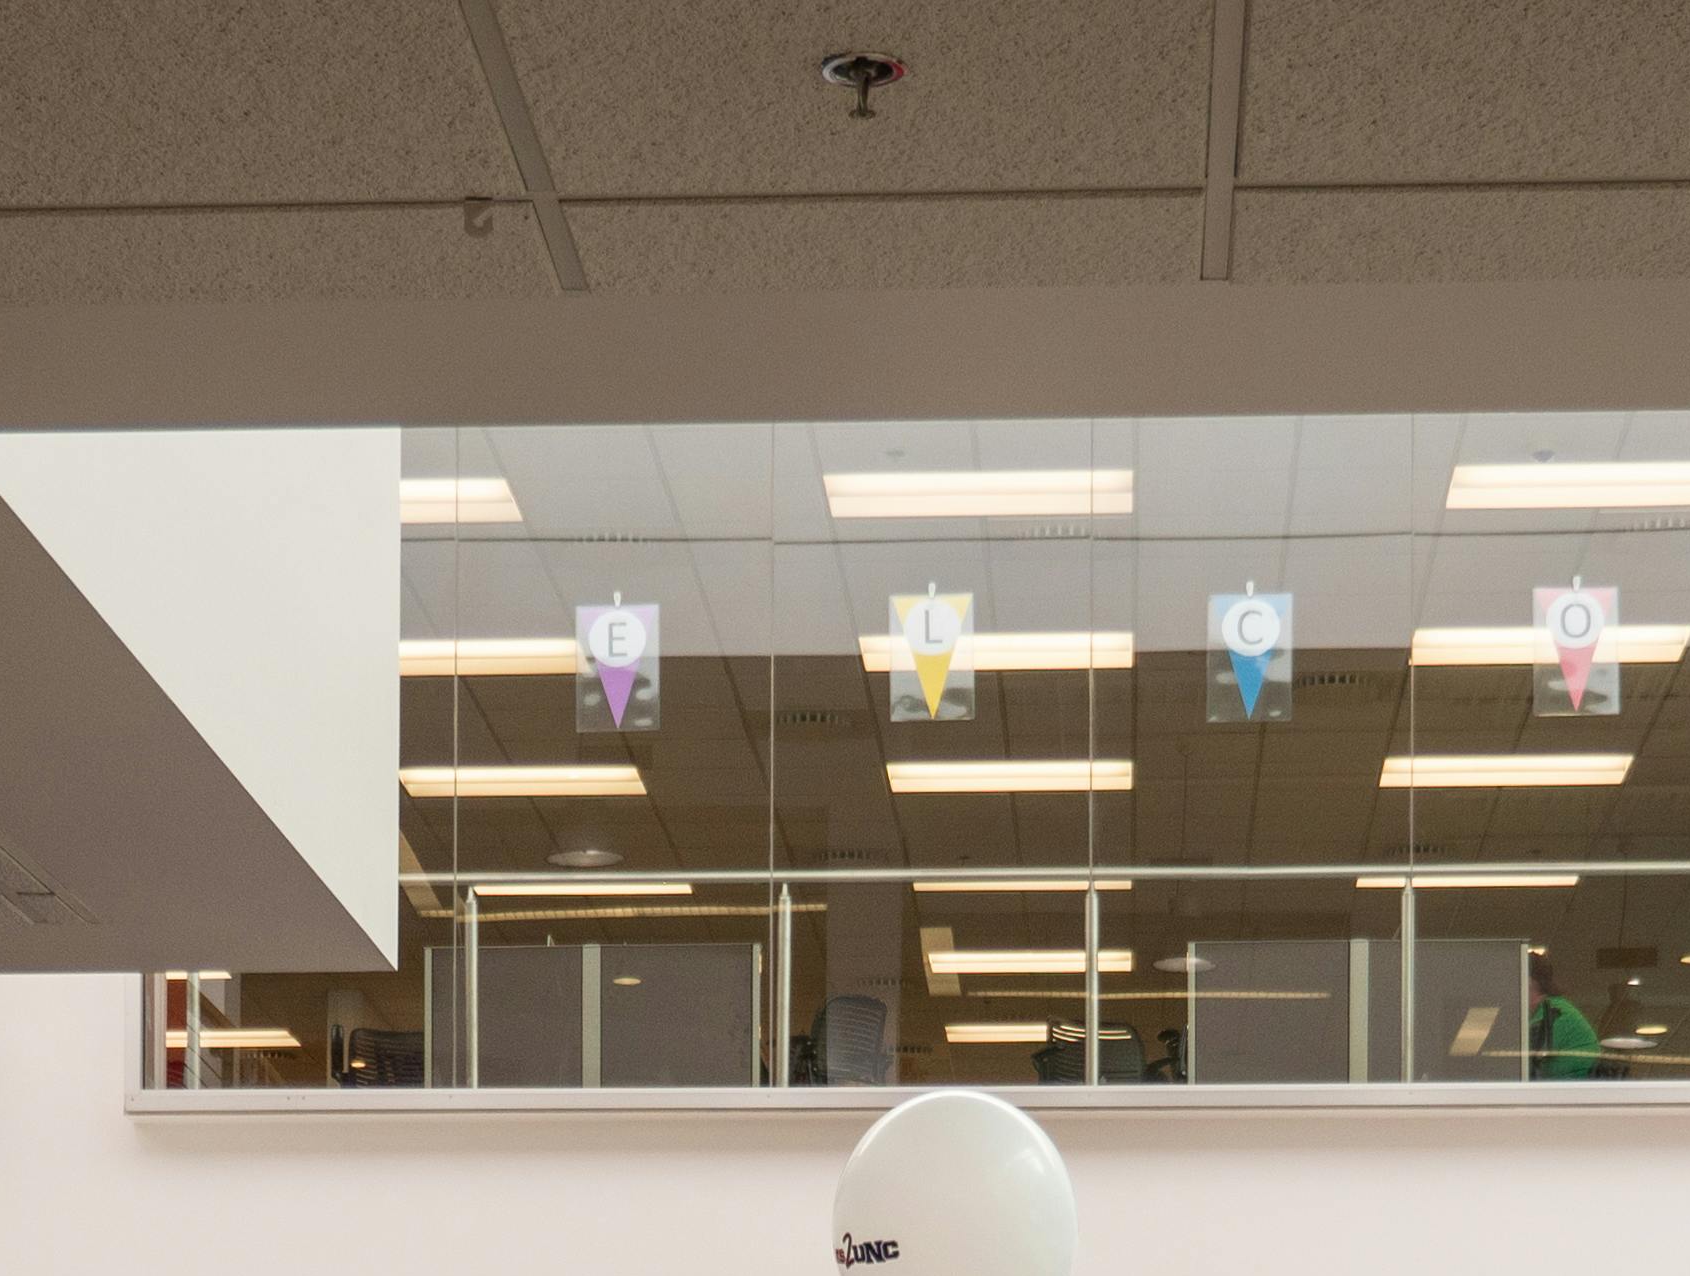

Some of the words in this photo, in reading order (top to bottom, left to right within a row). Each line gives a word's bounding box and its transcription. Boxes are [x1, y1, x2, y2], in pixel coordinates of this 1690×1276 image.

[608, 621, 628, 657] E
[923, 609, 943, 644] L
[1236, 609, 1264, 646] C
[1559, 602, 1593, 639] O
